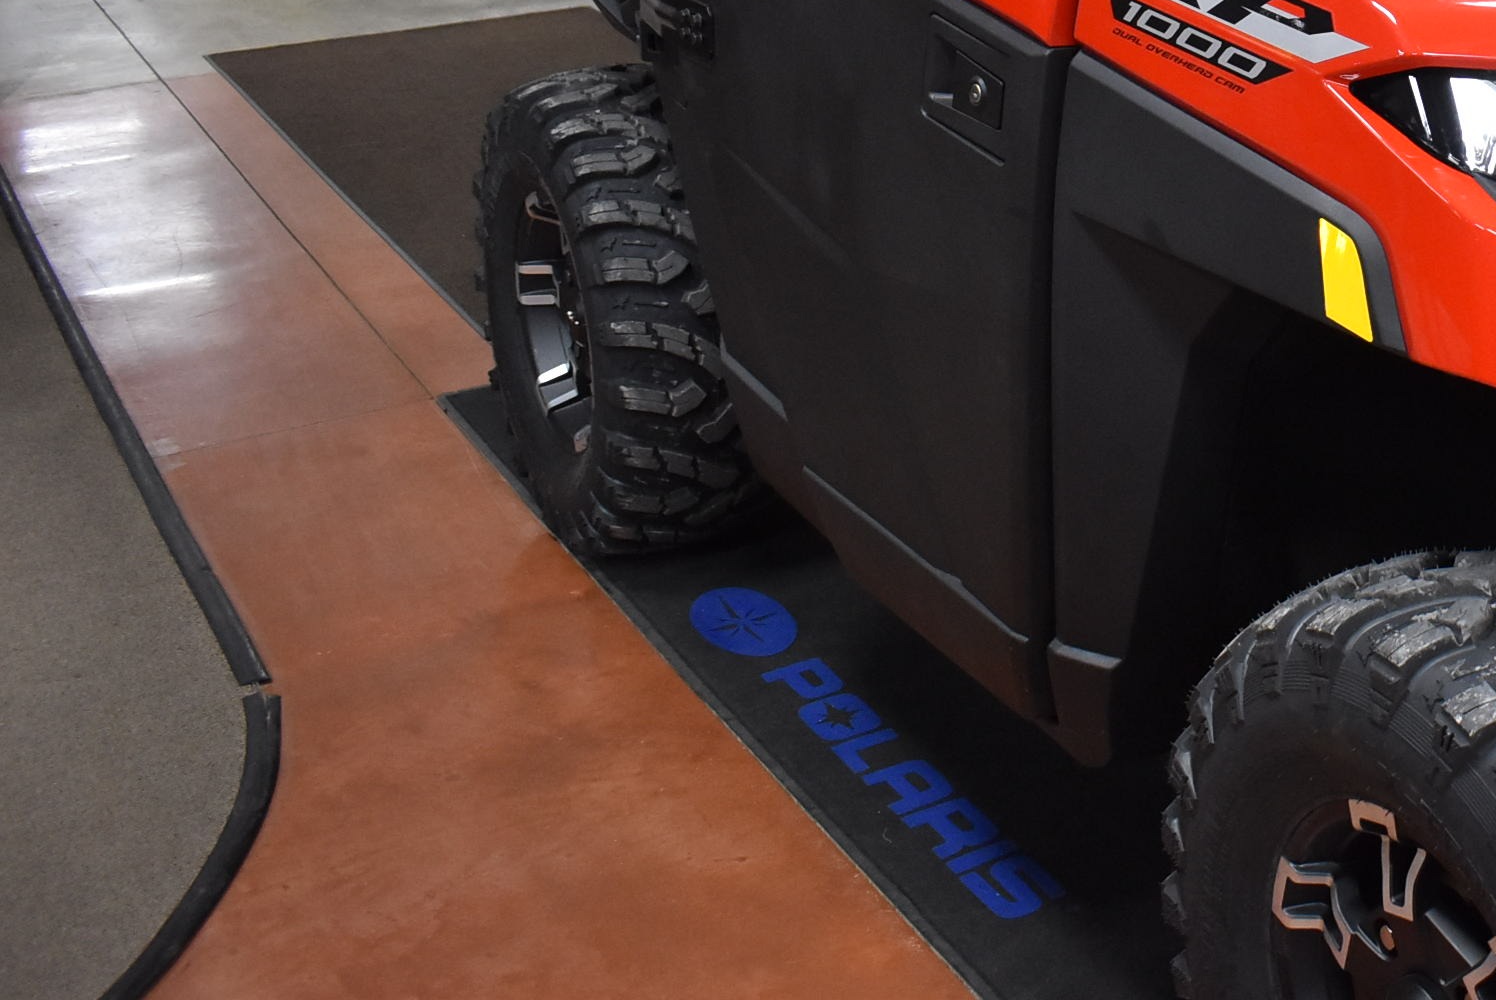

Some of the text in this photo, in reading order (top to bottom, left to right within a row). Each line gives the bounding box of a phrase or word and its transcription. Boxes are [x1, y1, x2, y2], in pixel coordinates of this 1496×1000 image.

[1112, 27, 1246, 94] DUAL OVERHEAD CAM
[1122, 1, 1268, 80] 1000
[761, 658, 1066, 919] POLARIS
